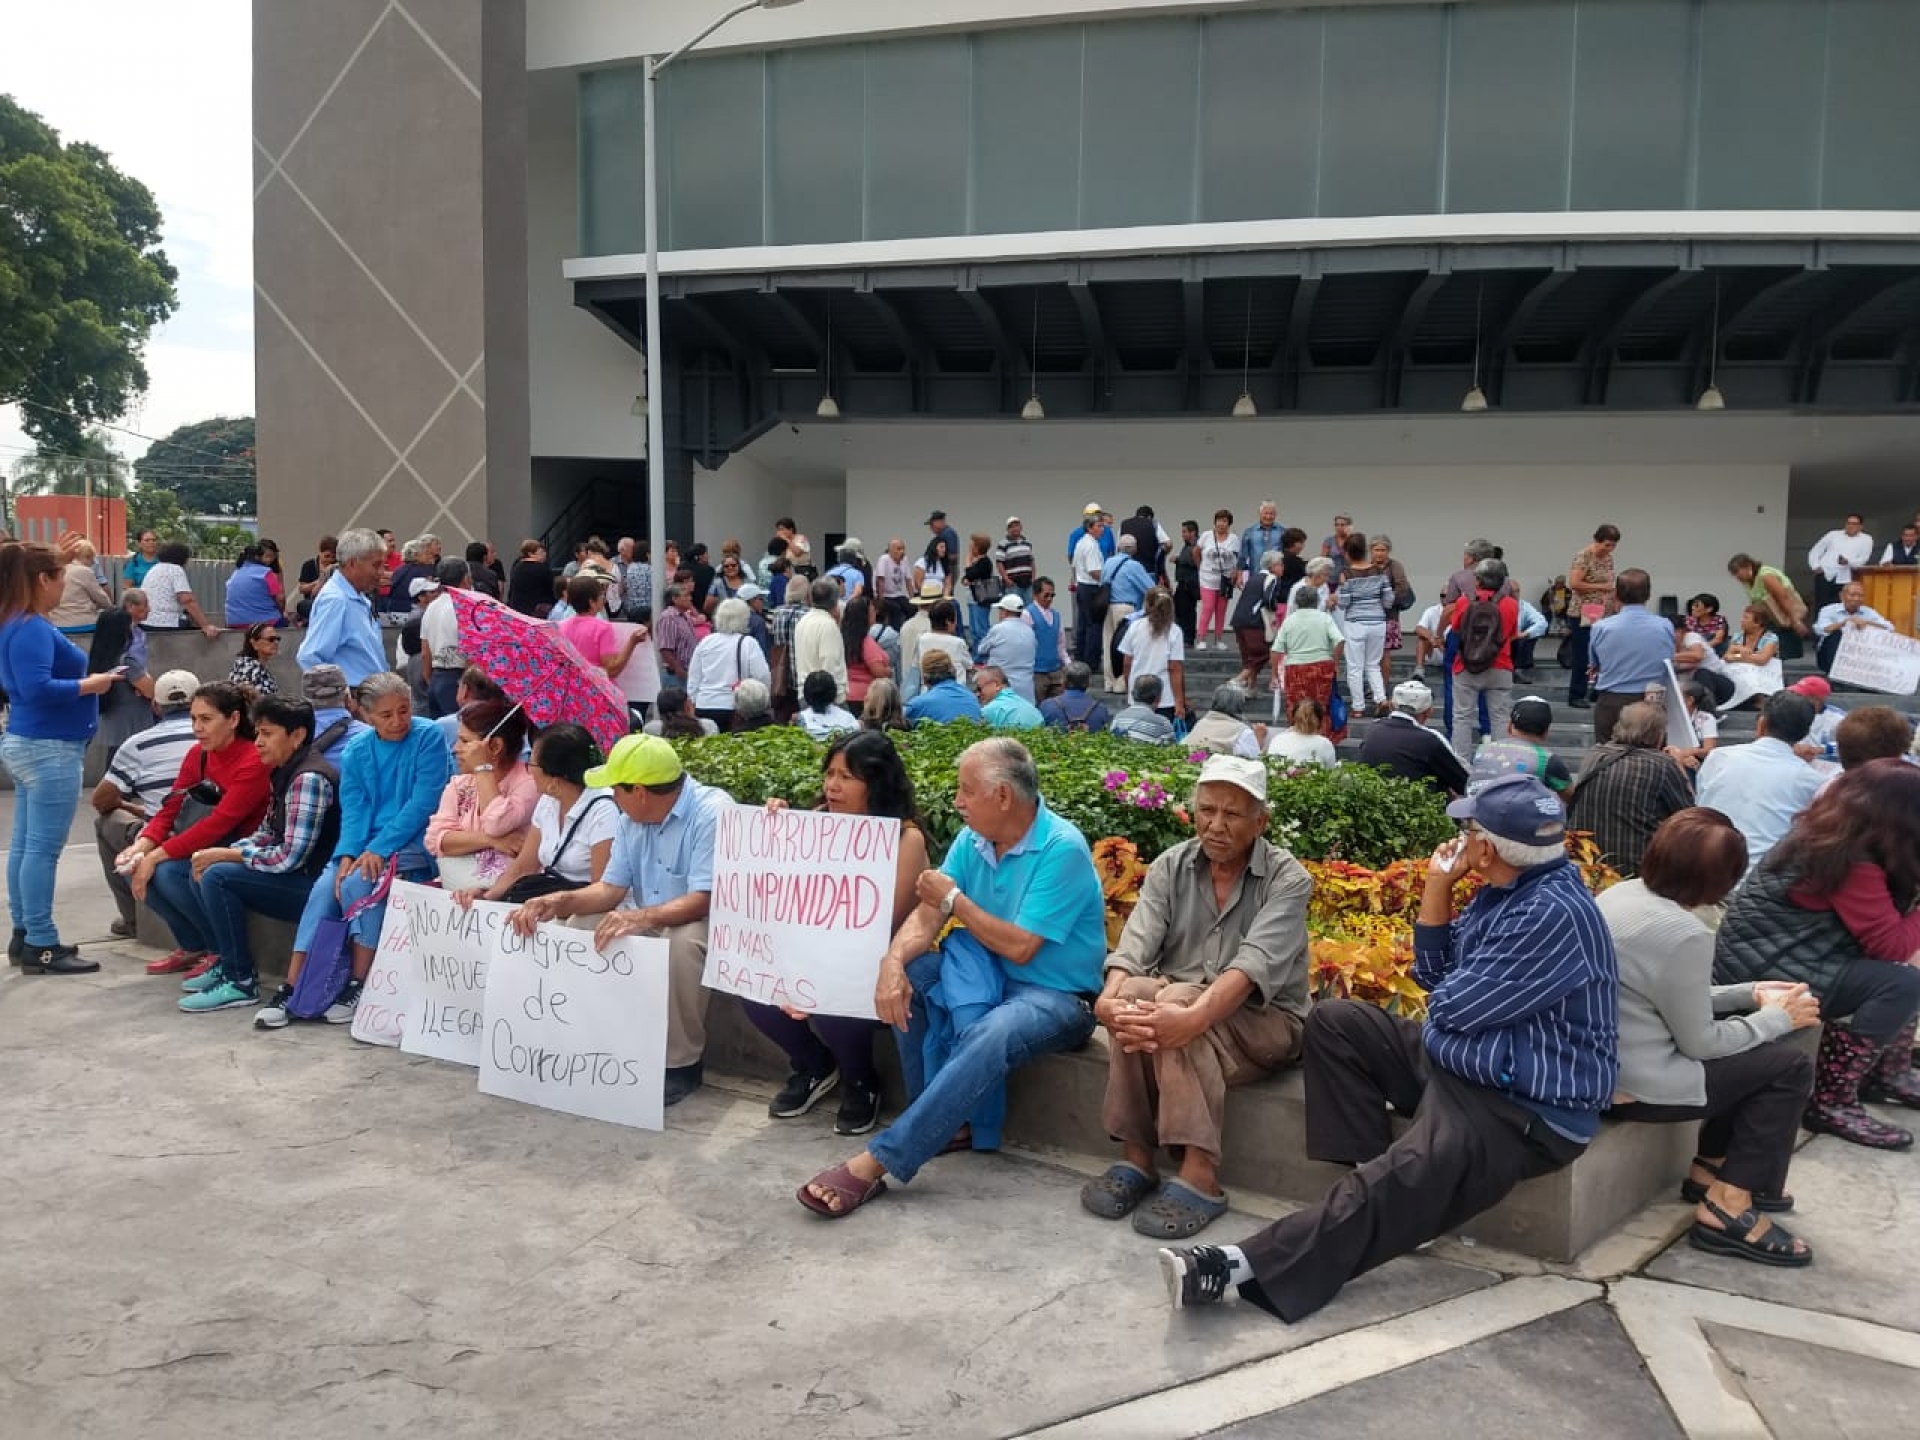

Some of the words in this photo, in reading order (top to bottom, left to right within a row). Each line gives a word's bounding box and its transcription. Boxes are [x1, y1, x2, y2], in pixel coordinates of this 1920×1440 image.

[719, 808, 743, 862] NO
[714, 872, 740, 913] NO
[746, 871, 880, 931] IMPUNIDAD
[712, 923, 732, 952] NO
[737, 929, 774, 965] MAS
[523, 977, 573, 1024] de
[716, 959, 817, 1009] RATAS
